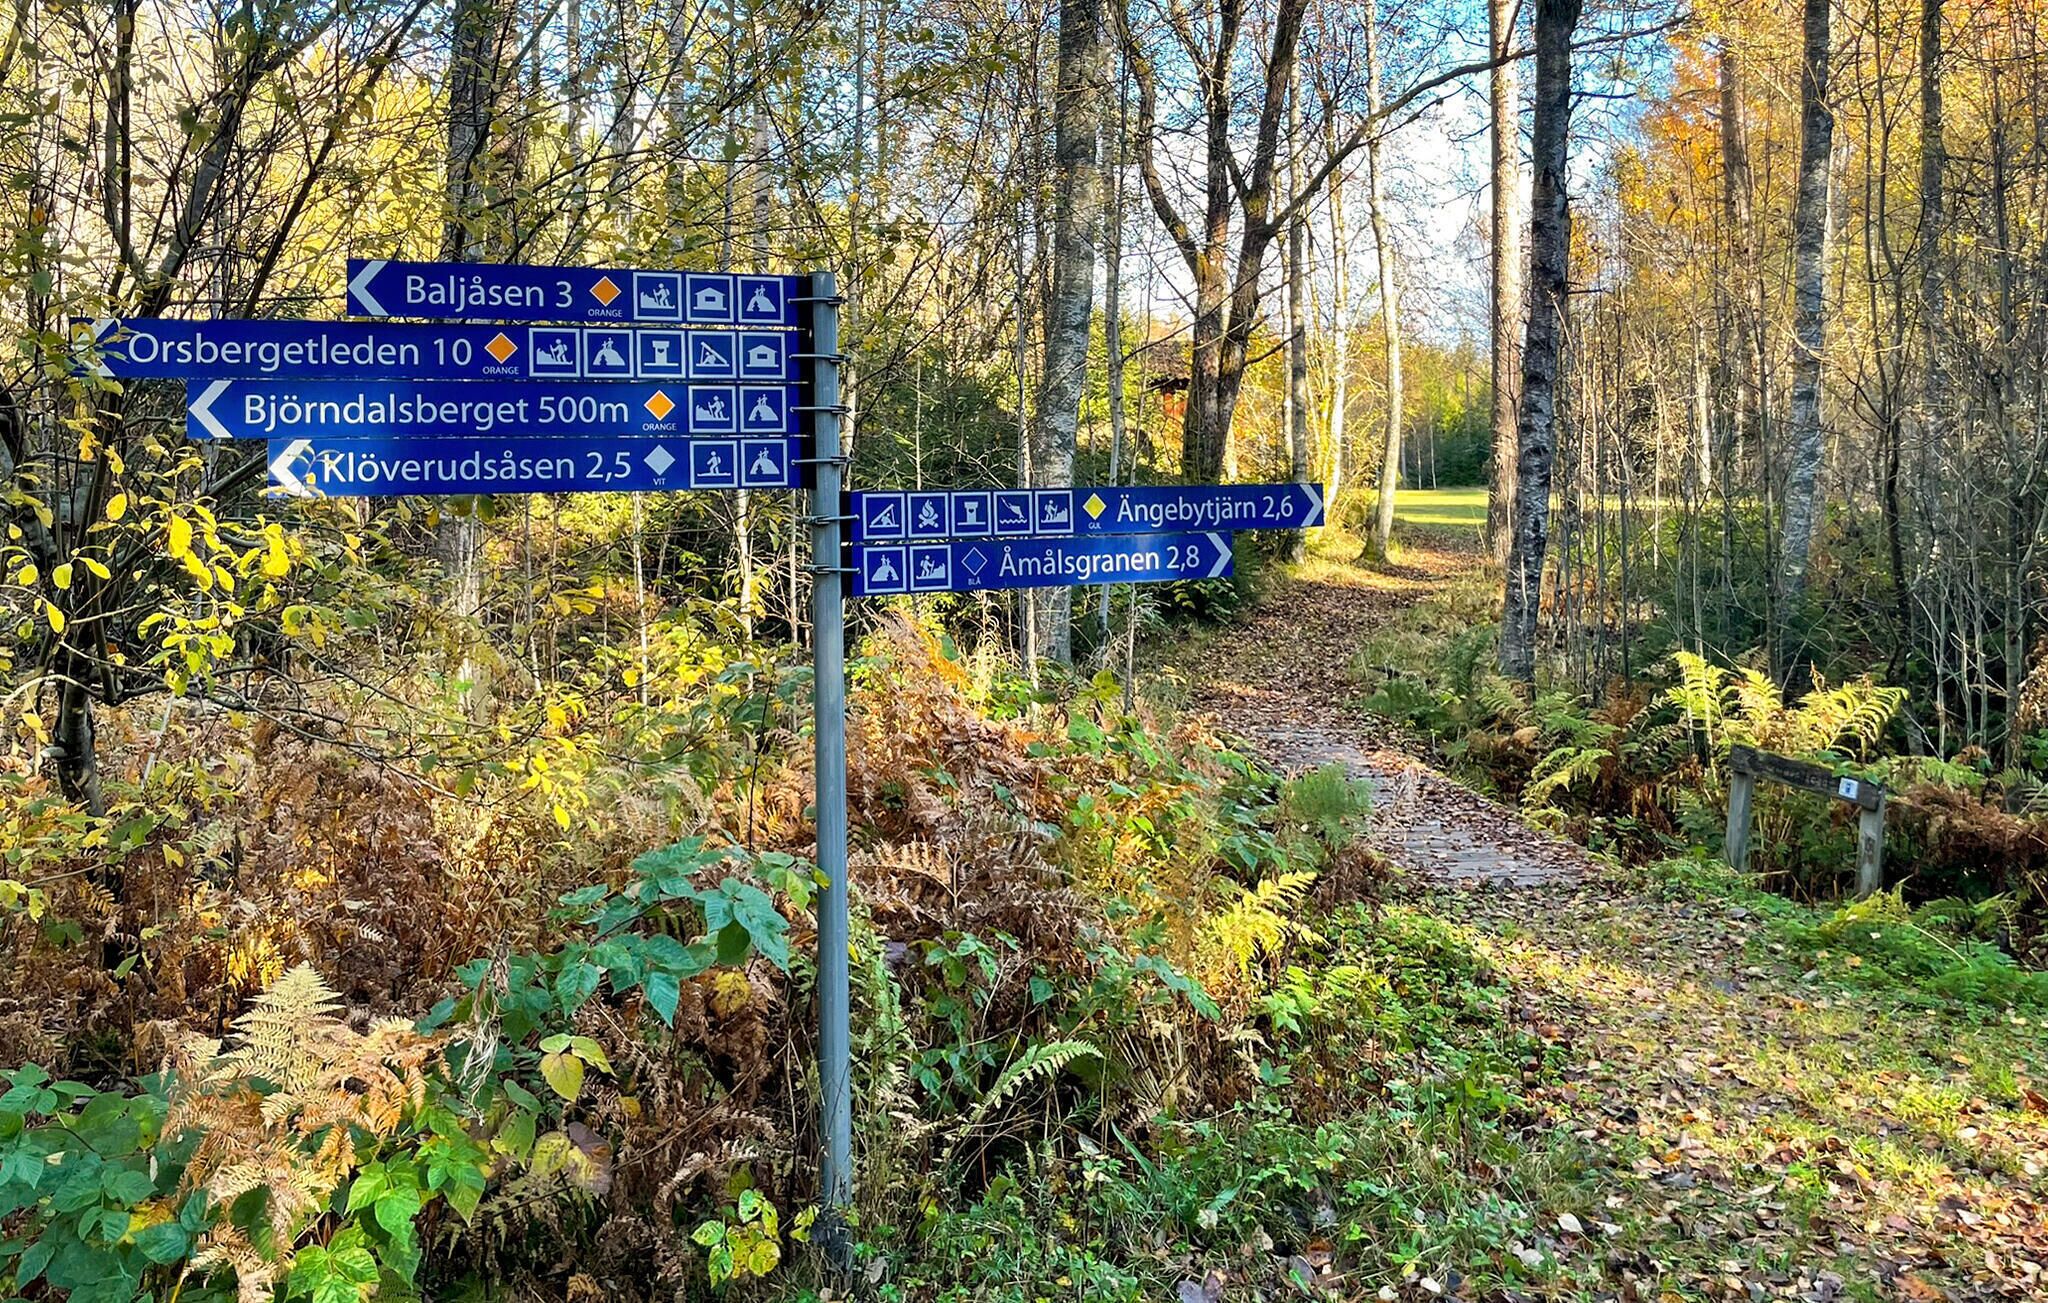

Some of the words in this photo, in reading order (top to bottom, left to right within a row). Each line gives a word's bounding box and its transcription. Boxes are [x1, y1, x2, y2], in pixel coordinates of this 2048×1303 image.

[406, 275, 544, 312] Baljåsen
[555, 281, 573, 308] 3
[587, 308, 623, 318] ORANGE
[128, 332, 419, 372] Orsbergetleden
[433, 338, 472, 366] 10
[481, 365, 520, 375] ORANGE
[245, 393, 529, 433] Björndalsberget
[538, 396, 629, 423] 500m
[642, 422, 677, 432] ORANGE
[323, 450, 575, 482] Klöverudsåsen
[585, 451, 631, 483] 2,5
[652, 478, 666, 486] VIT
[1116, 494, 1256, 528] Ängebytjärn
[1262, 495, 1294, 521] 2,6
[1088, 521, 1102, 530] GUL
[999, 545, 1160, 580] Åmålsgranen
[1166, 545, 1200, 572] 2,8
[967, 576, 982, 587] BLÅ
